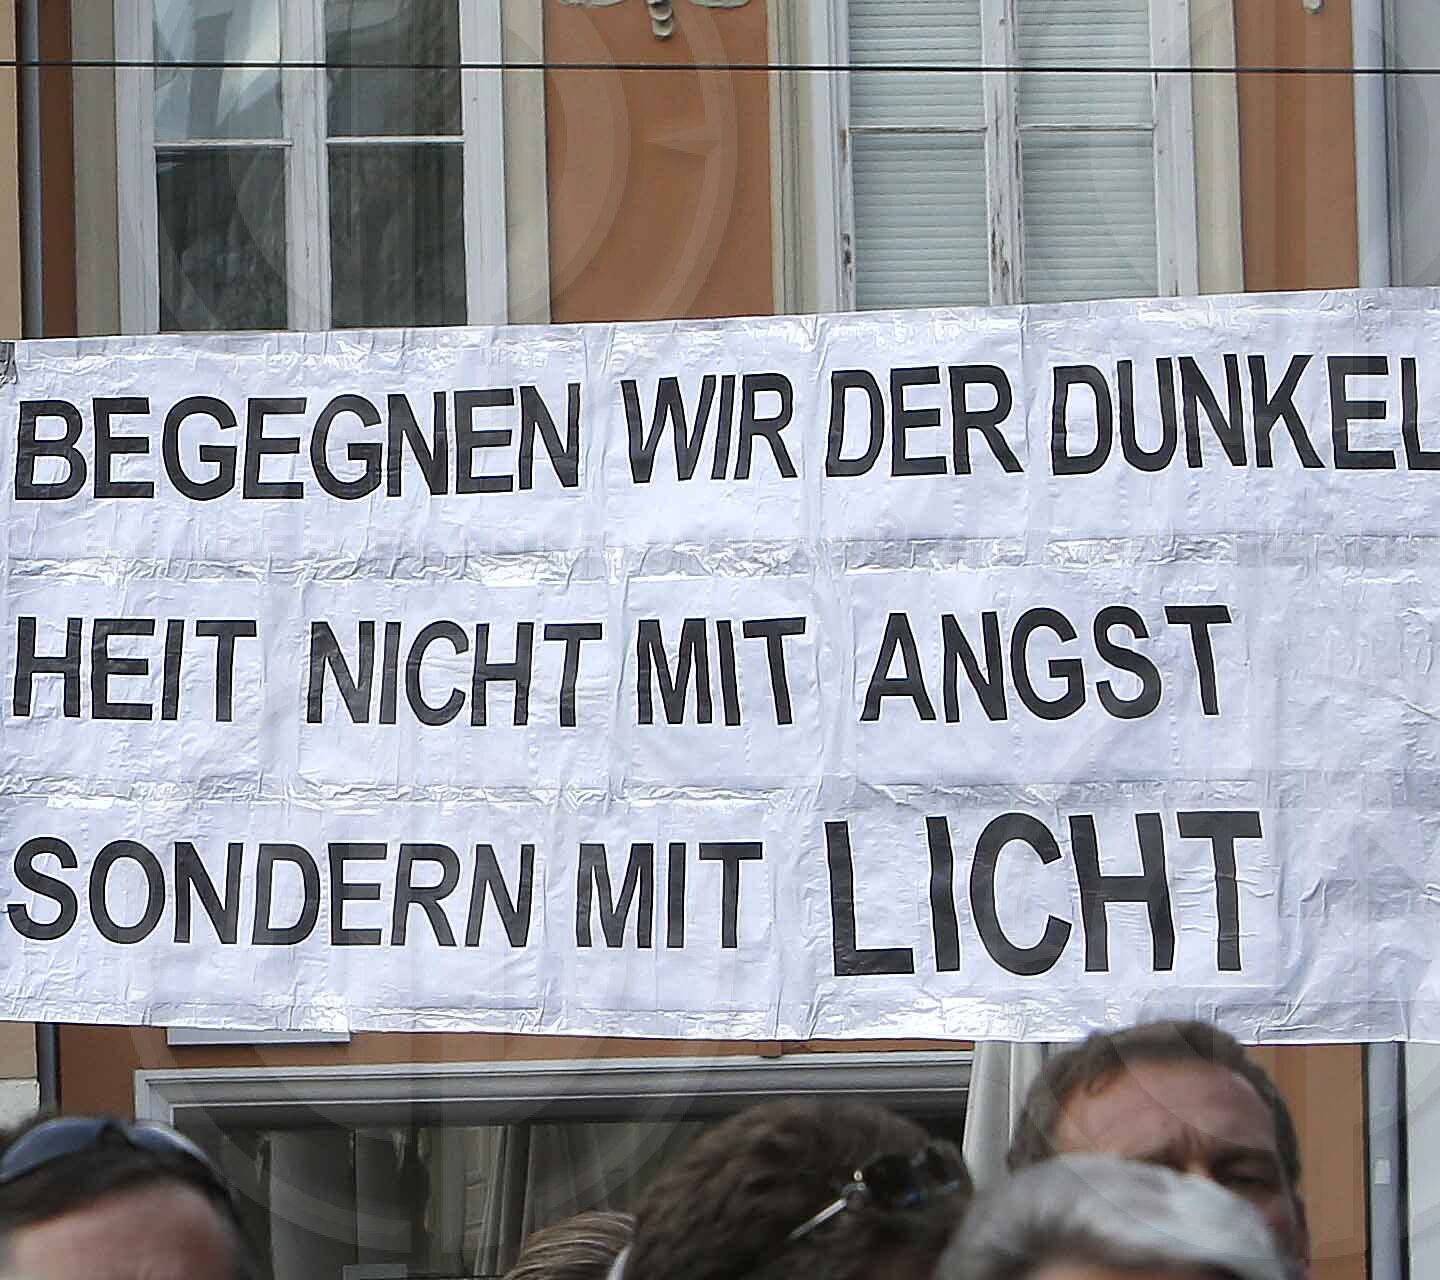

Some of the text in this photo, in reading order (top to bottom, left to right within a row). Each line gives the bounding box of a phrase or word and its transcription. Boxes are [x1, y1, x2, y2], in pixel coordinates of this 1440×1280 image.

[14, 381, 581, 502] BEGEGNEN
[620, 372, 799, 484] WIR
[824, 364, 1026, 479] DER
[12, 604, 1232, 728] HEIT NICHT MIT ANGST
[1, 810, 1263, 977] SONDERN MIT LICHT
